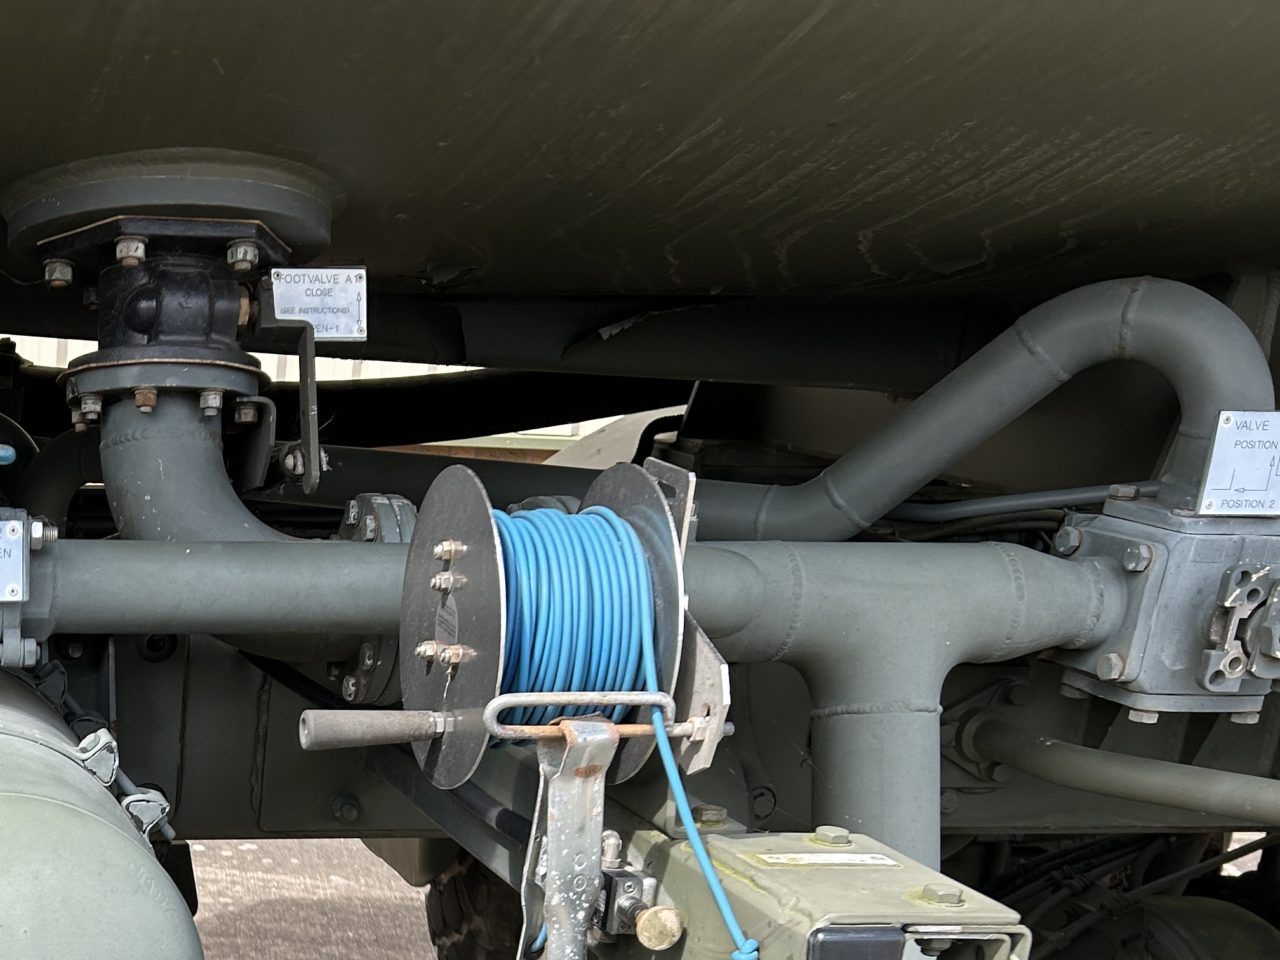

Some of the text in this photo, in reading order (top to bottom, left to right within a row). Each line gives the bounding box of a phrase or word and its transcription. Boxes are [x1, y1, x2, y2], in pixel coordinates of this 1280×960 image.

[278, 273, 340, 284] FOOTVALVE
[305, 288, 333, 297] CLOSE
[1235, 420, 1270, 431] VALVE
[1234, 440, 1279, 449] POSITION
[1221, 500, 1276, 508] POSITION 2
